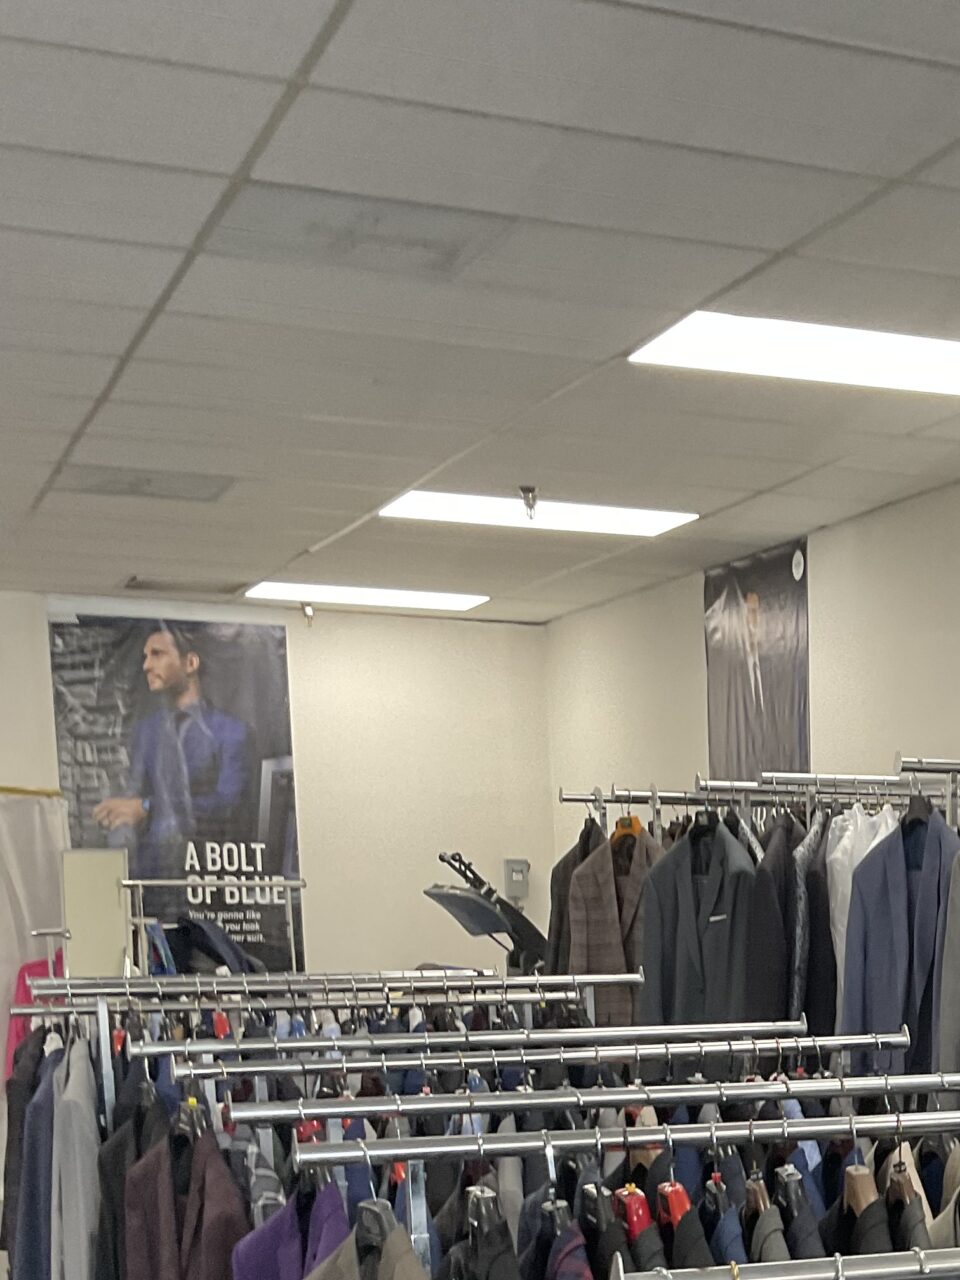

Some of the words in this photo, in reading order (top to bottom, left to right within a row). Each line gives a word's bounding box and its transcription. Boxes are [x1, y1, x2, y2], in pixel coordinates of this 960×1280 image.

[185, 841, 200, 871] A
[205, 841, 266, 872] BOLT
[186, 874, 217, 905] OF
[224, 875, 286, 905] BLUE
[217, 911, 244, 923] gonna
[246, 909, 261, 920] like
[225, 922, 240, 934] you
[242, 921, 260, 931] look
